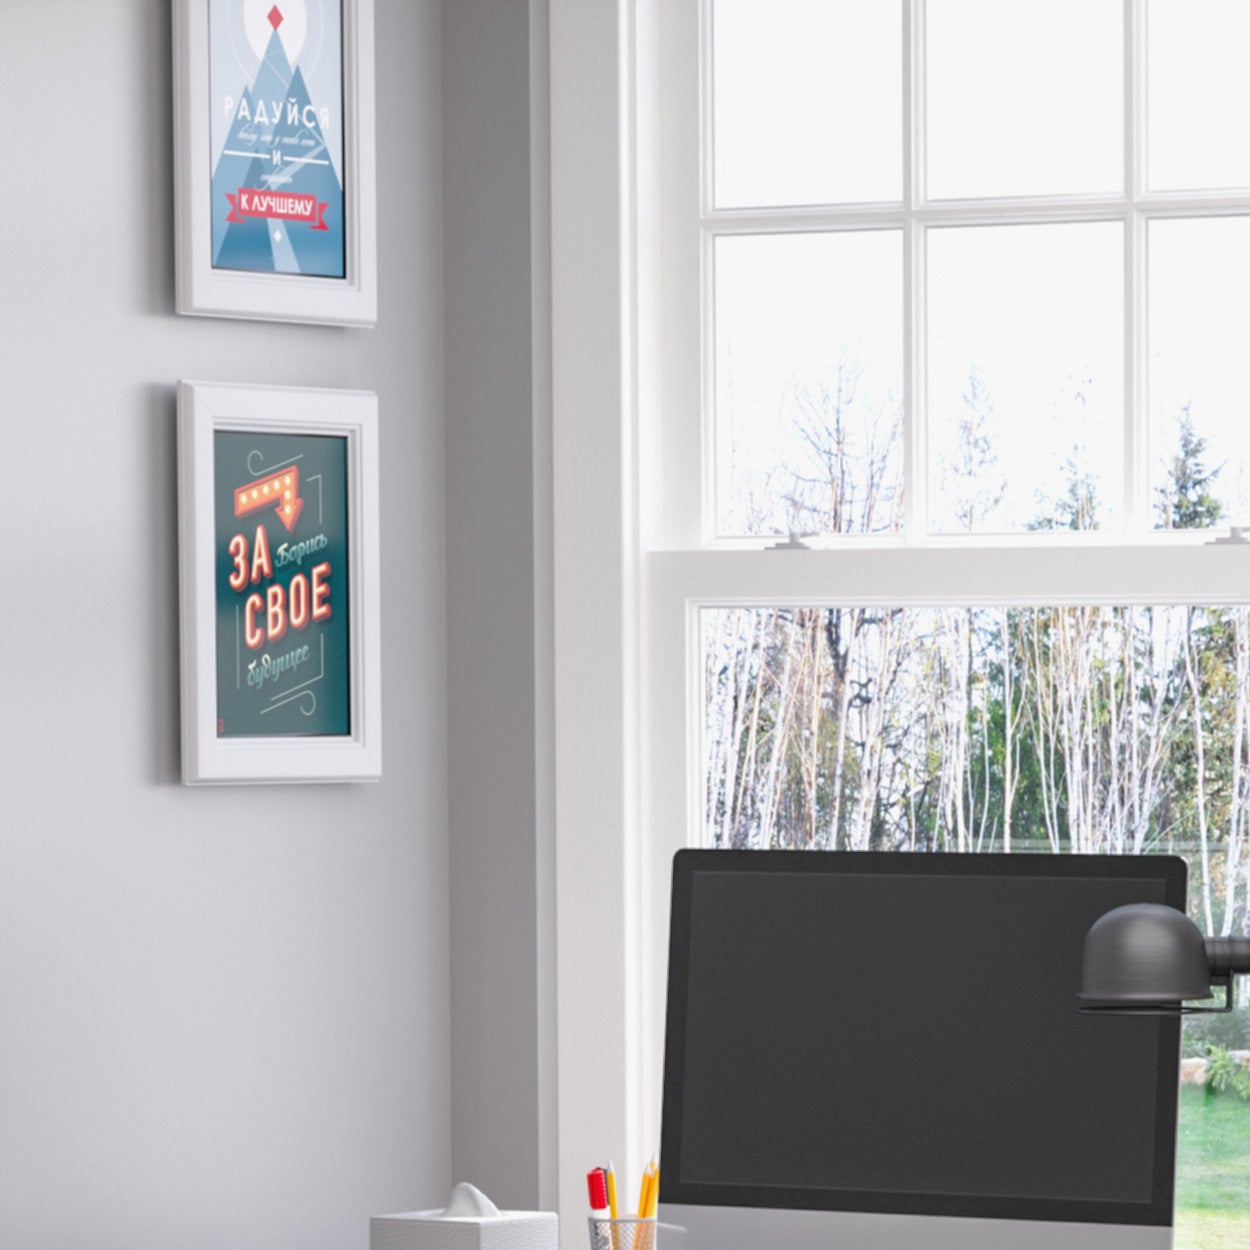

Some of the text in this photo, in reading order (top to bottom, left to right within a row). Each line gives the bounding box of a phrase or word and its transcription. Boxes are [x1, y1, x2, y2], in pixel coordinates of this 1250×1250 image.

[224, 96, 329, 130] РАДУЙСЯ
[272, 150, 281, 166] И
[241, 194, 313, 217] К ЛУЧШЕМУ
[229, 525, 273, 592] ЗА
[244, 562, 331, 650] СВОЕ
[247, 645, 310, 689] будущее
